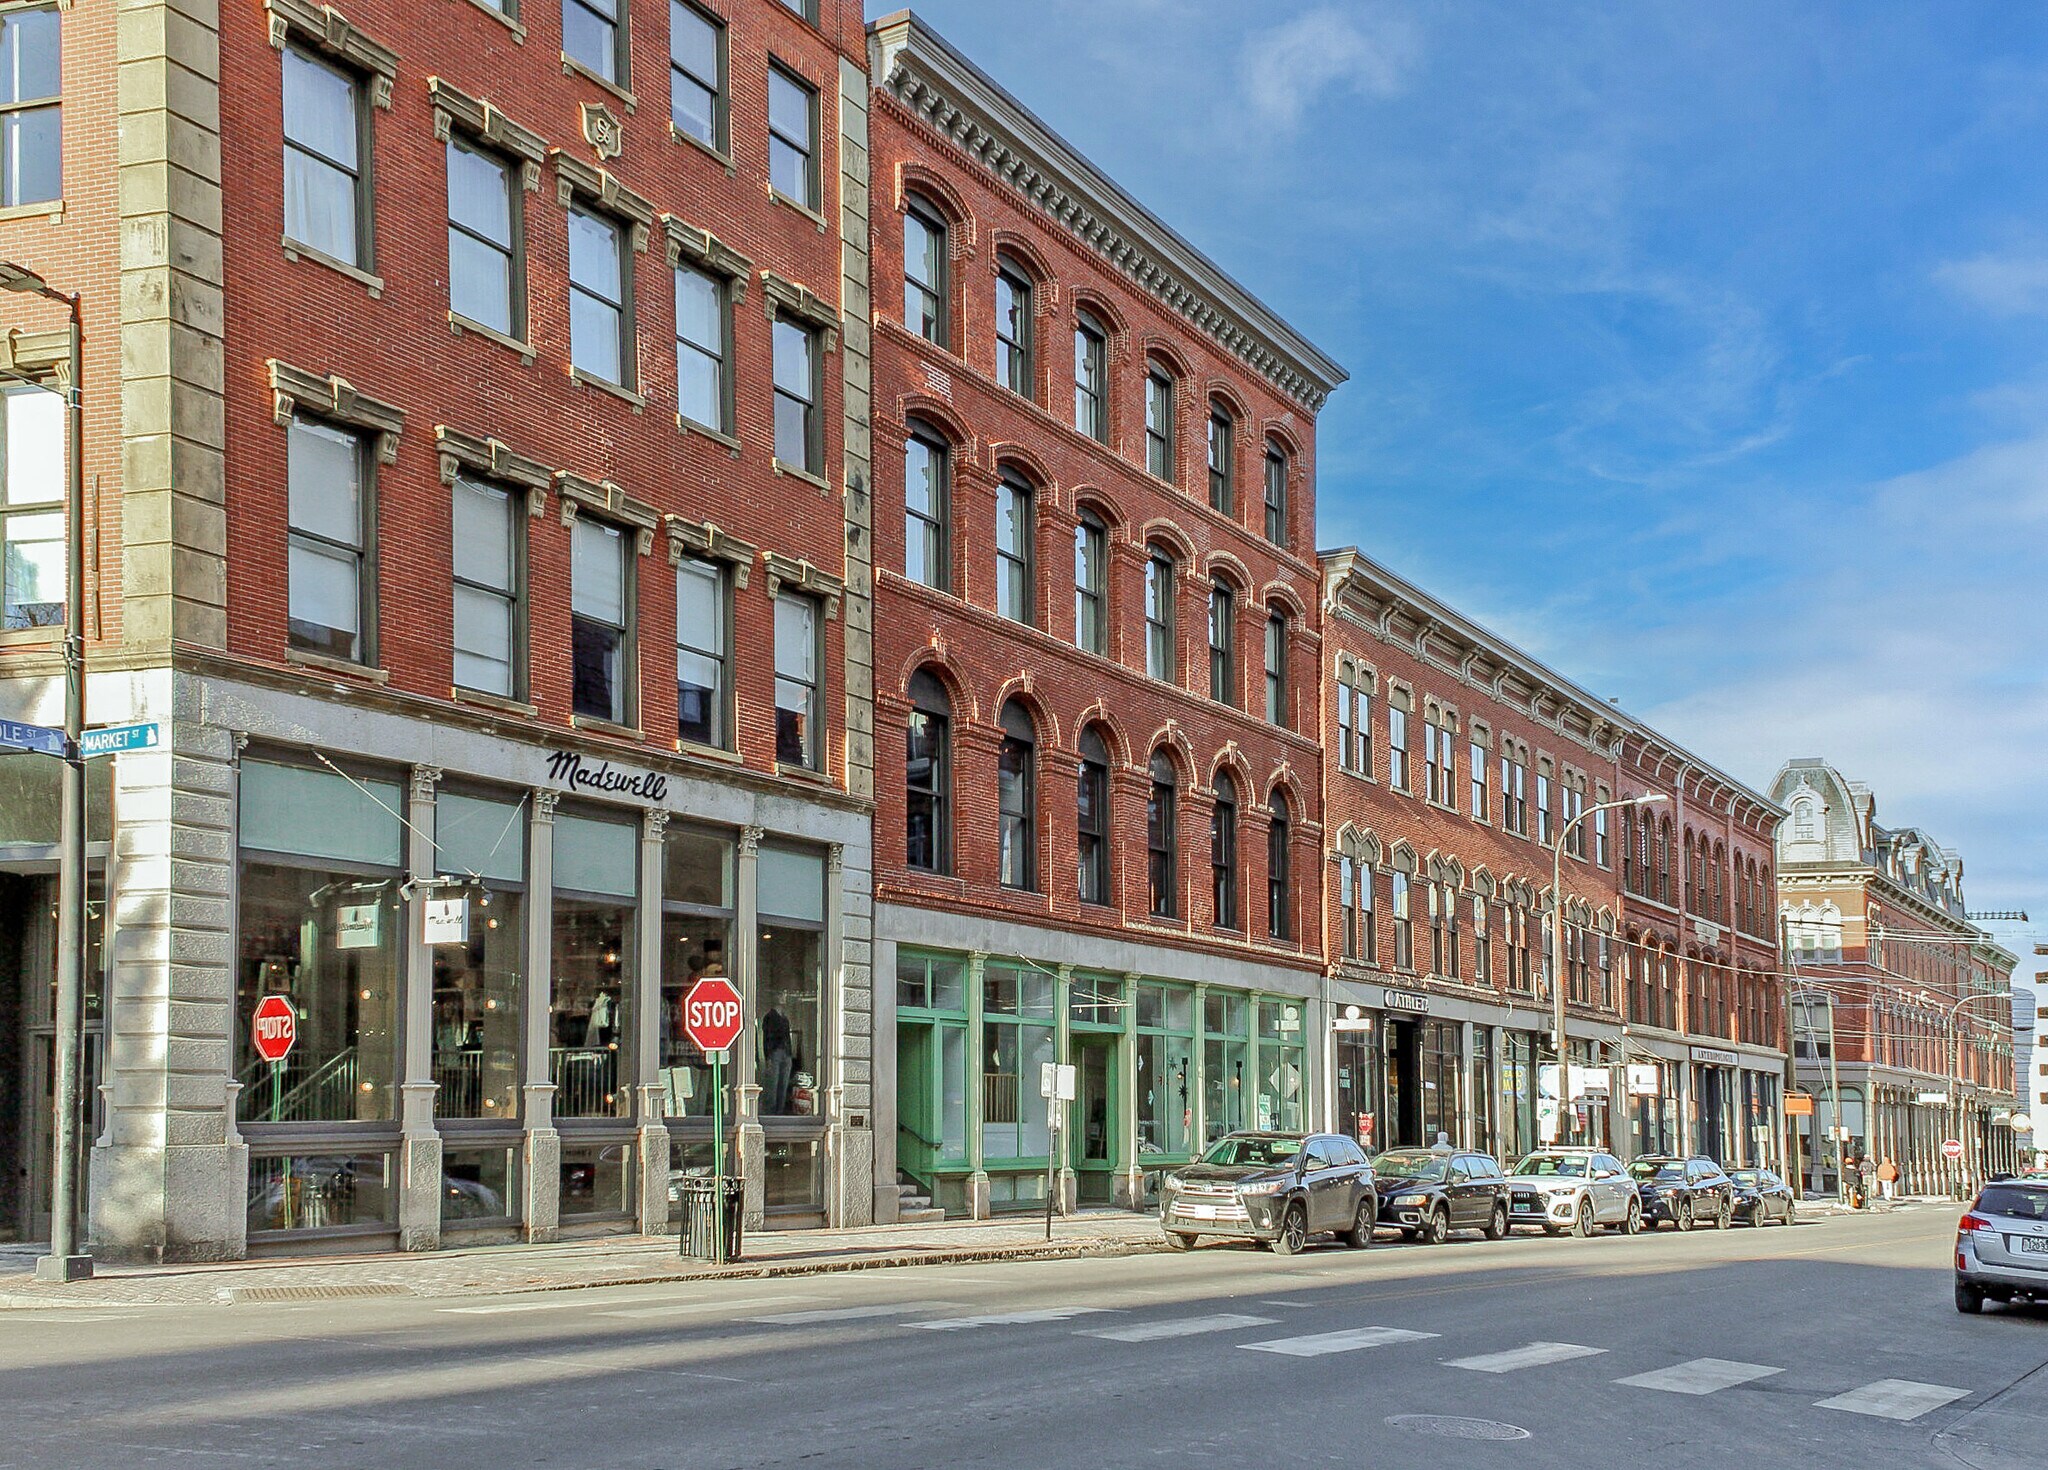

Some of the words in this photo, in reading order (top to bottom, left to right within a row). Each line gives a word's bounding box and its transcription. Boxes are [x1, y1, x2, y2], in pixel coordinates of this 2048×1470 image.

[0, 723, 23, 742] LE
[27, 729, 37, 738] ST
[85, 730, 130, 751] MARKET
[132, 729, 140, 738] ST
[546, 750, 667, 801] Madewell
[690, 1001, 739, 1028] STOP
